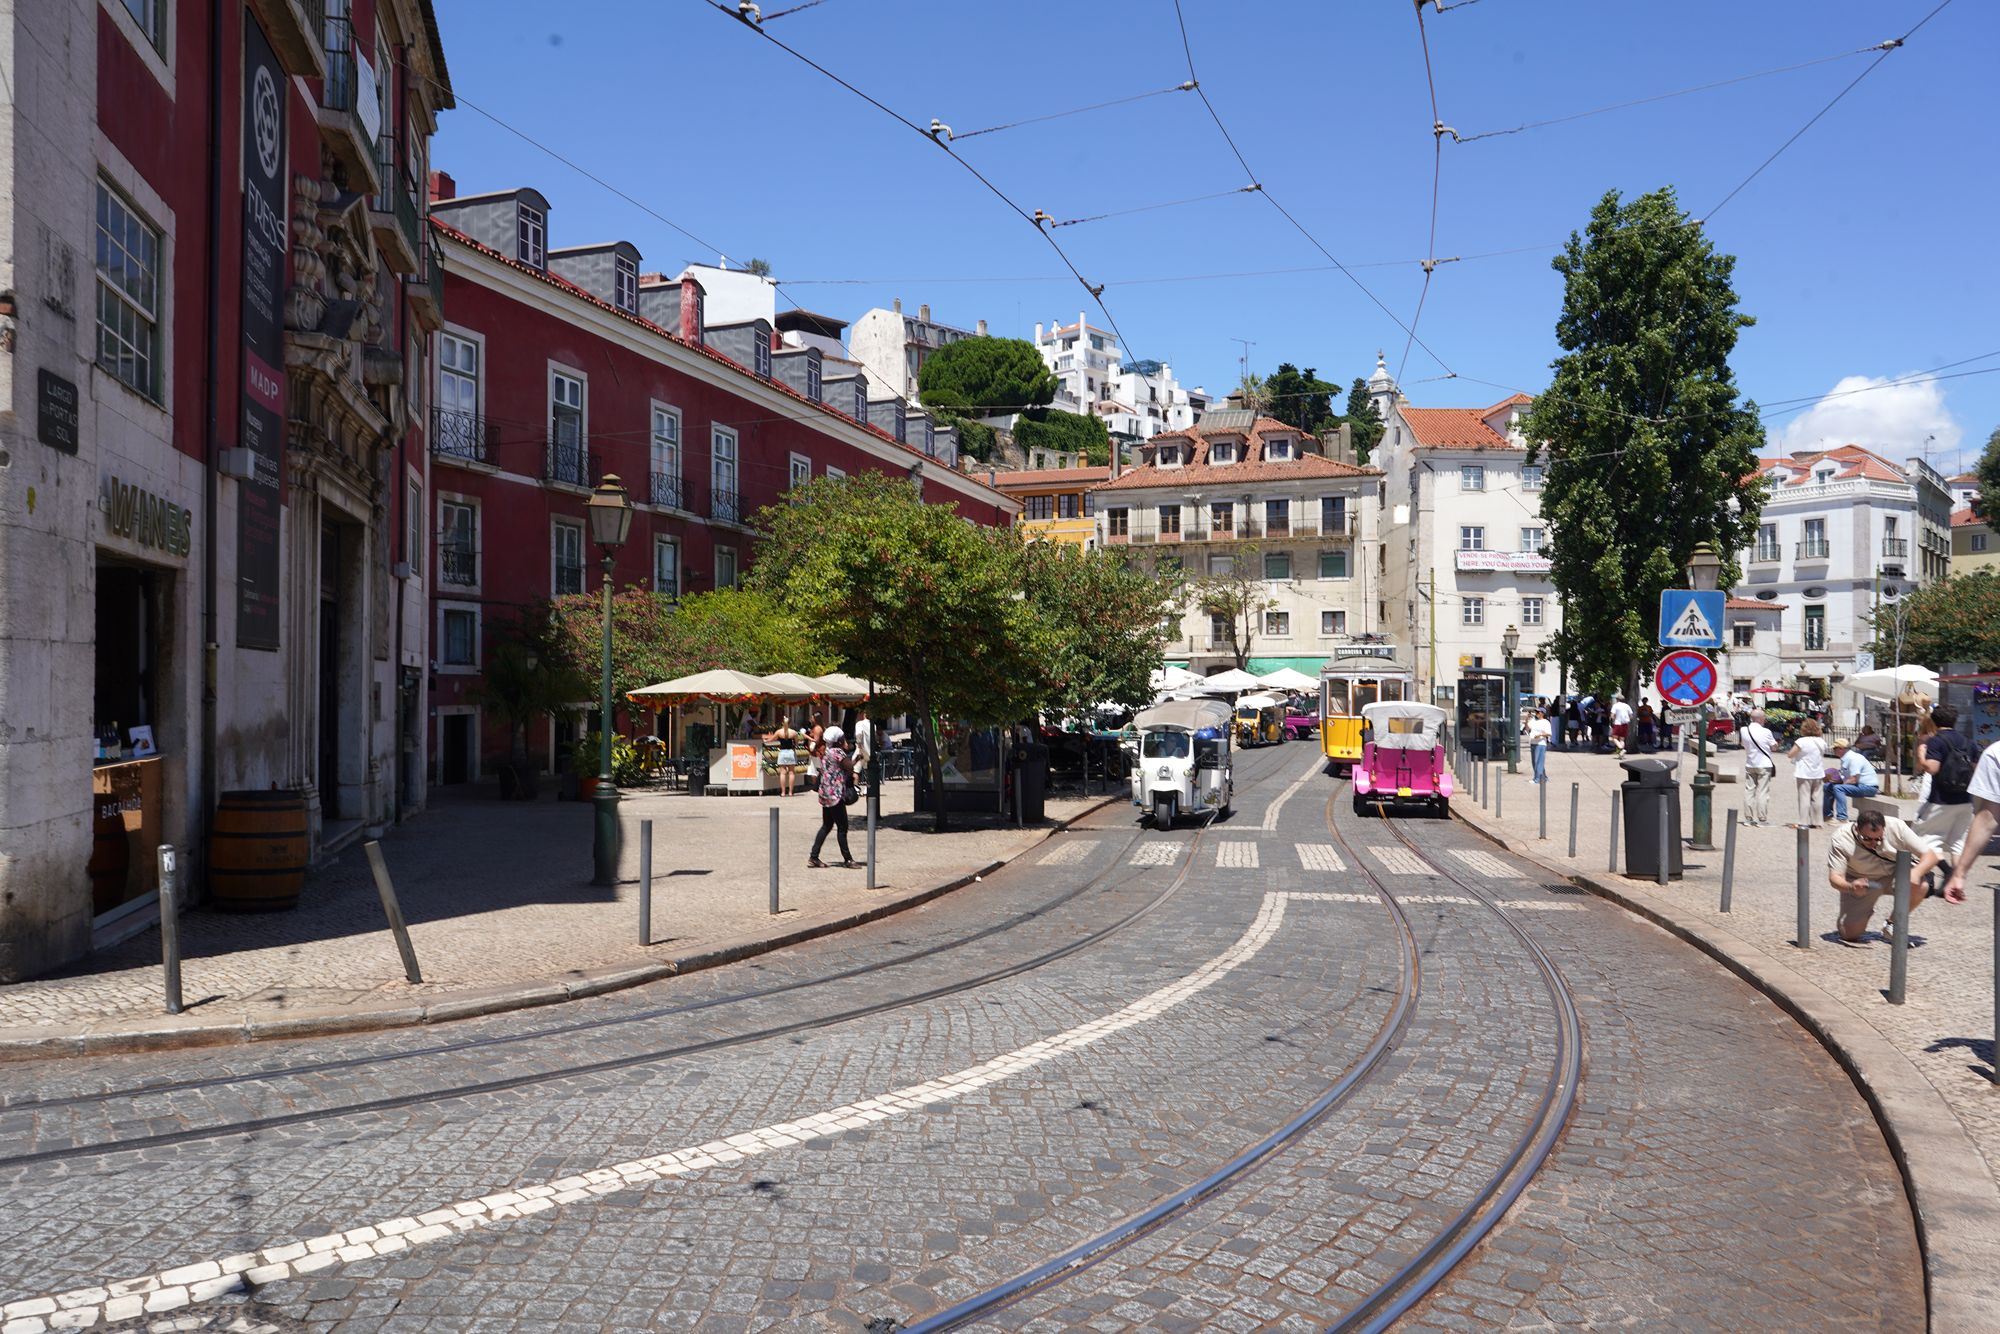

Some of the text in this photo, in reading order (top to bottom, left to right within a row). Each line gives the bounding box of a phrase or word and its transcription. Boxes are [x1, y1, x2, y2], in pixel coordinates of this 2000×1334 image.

[248, 177, 287, 255] FRESS
[47, 380, 73, 406] LARGO
[251, 366, 279, 400] MADP
[49, 401, 78, 427] PORTAS
[56, 425, 72, 444] SOL
[111, 475, 192, 558] WINES
